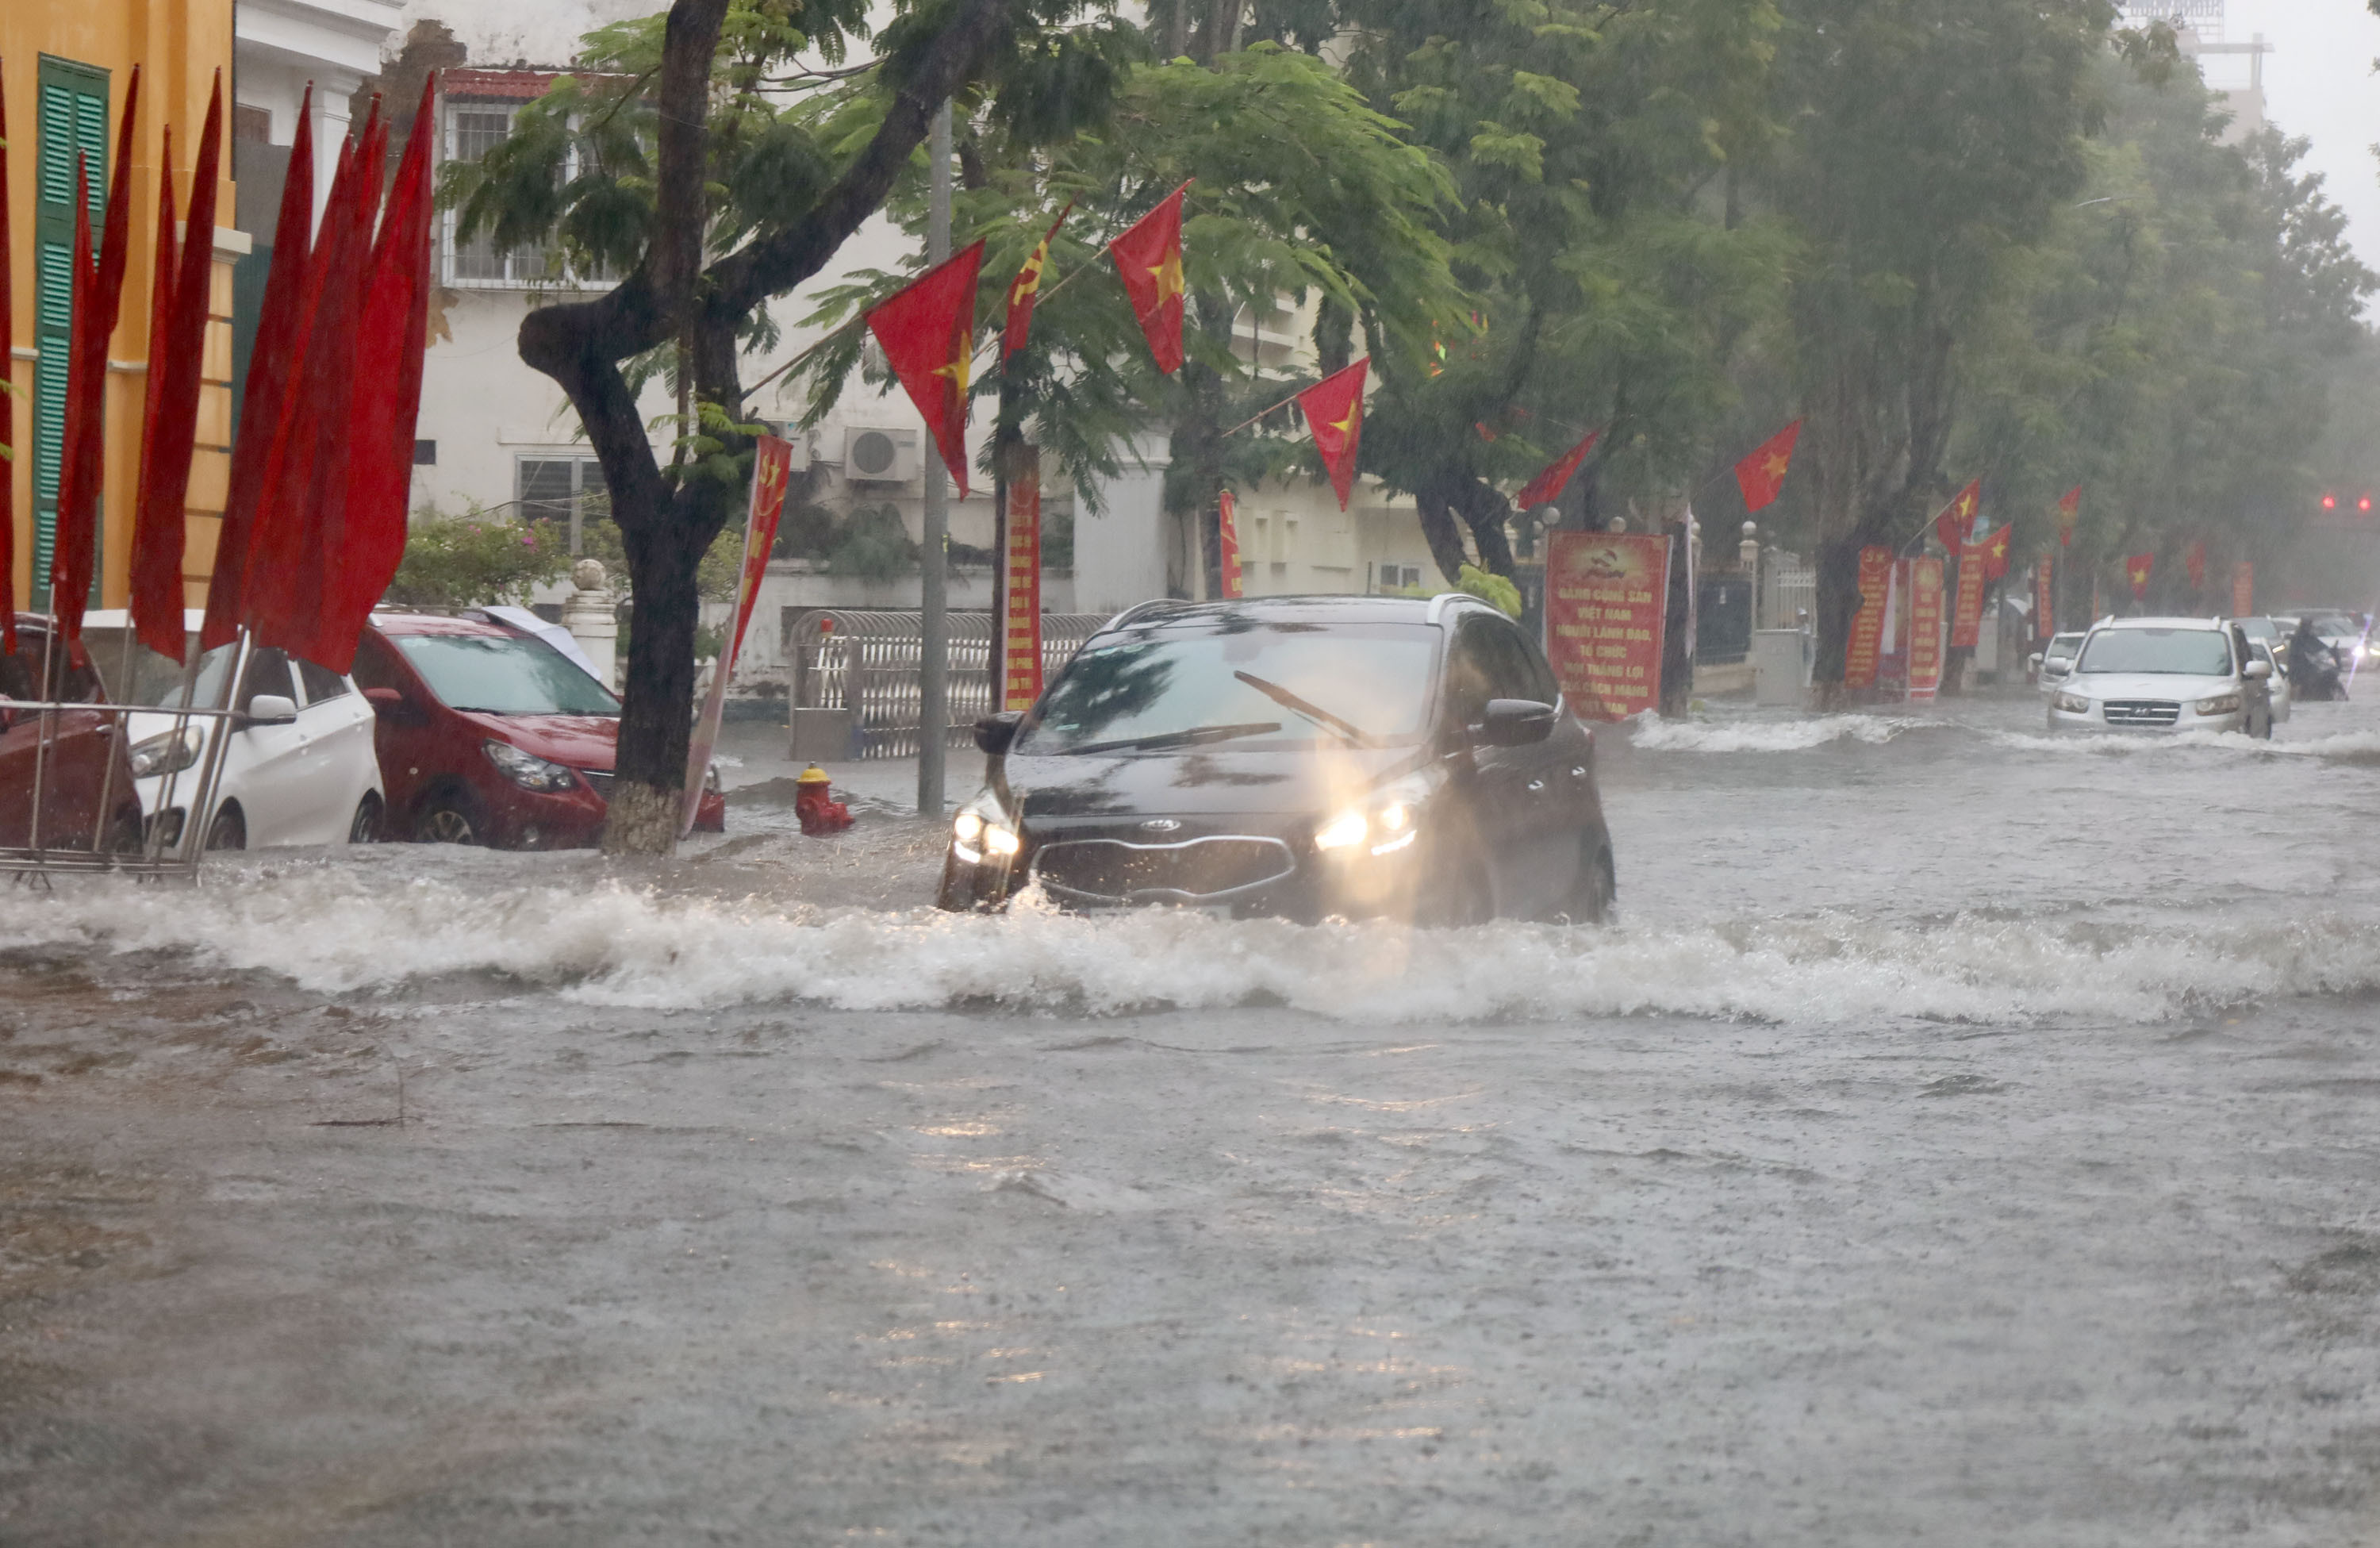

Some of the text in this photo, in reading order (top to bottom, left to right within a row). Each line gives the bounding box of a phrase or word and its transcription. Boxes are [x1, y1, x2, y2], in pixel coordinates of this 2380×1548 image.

[1578, 606, 1631, 620] VIỆT NAM
[1627, 666, 1645, 680] LỢI
